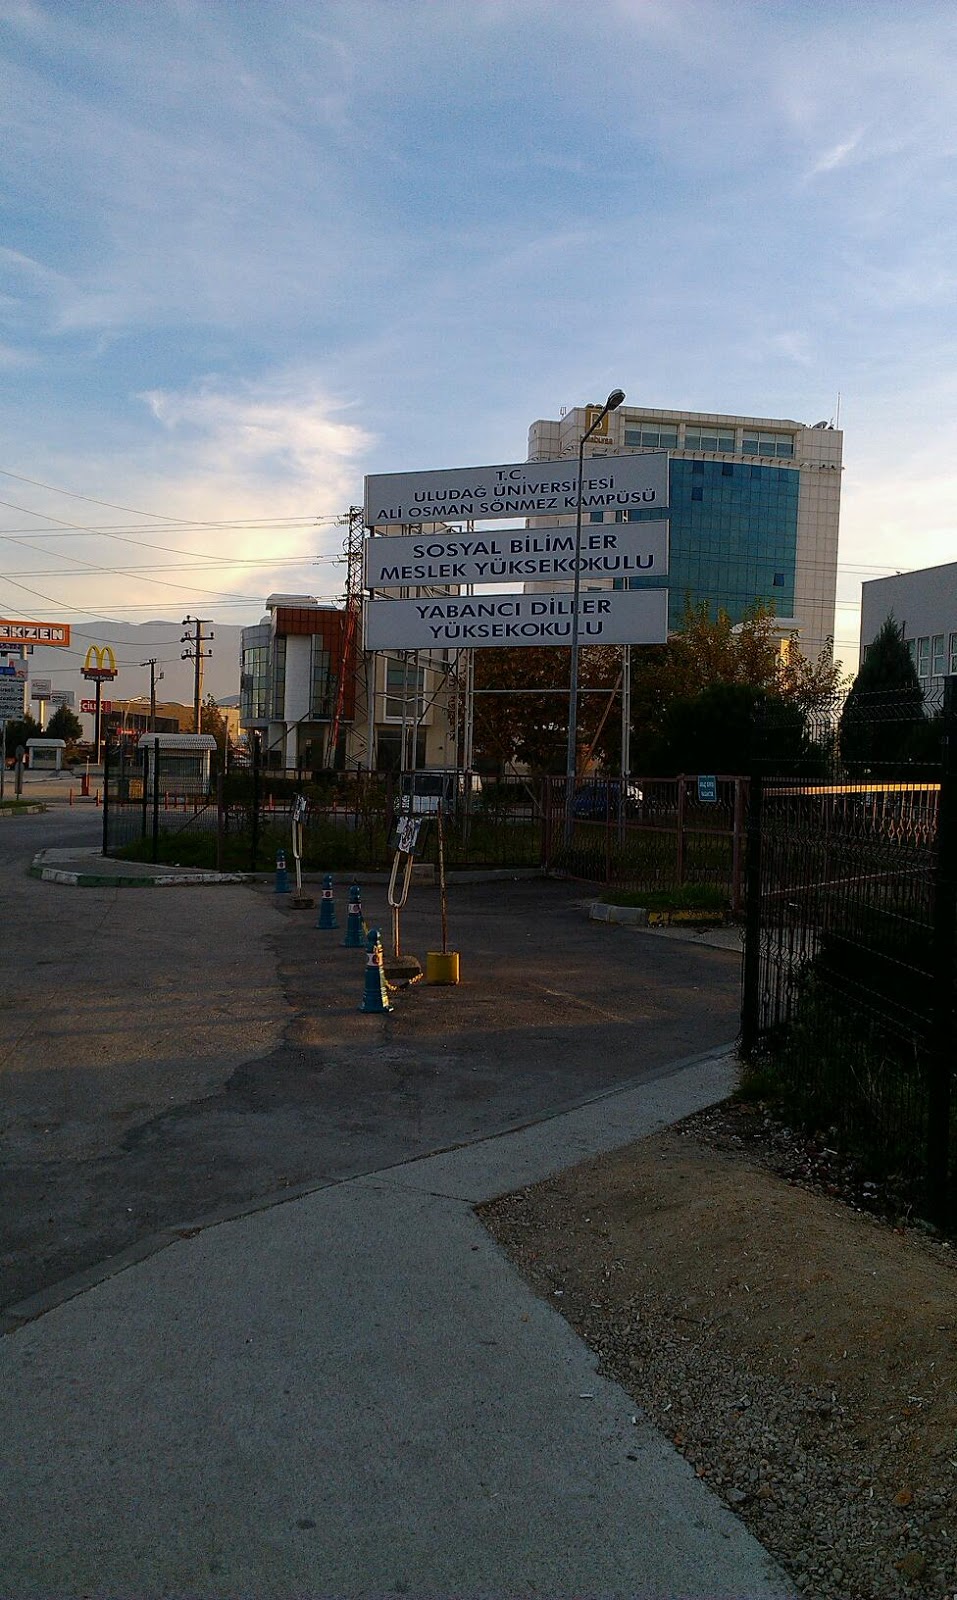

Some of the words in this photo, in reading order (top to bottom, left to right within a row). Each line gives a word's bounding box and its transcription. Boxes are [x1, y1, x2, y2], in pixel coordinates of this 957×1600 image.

[495, 469, 526, 481] T.C.
[414, 484, 487, 502] ULUDAĞ
[377, 505, 402, 520] ALİ
[408, 502, 473, 518] OSMAN
[480, 498, 558, 513] SÖNMEZ
[564, 488, 656, 508] KAMPÜSÜ
[413, 539, 501, 559] SOSYAL
[380, 562, 467, 580] MESLEK
[475, 553, 654, 575] YÜKSEKOKULU
[416, 602, 520, 620] YABANCI
[82, 700, 104, 712] ÇİLK
